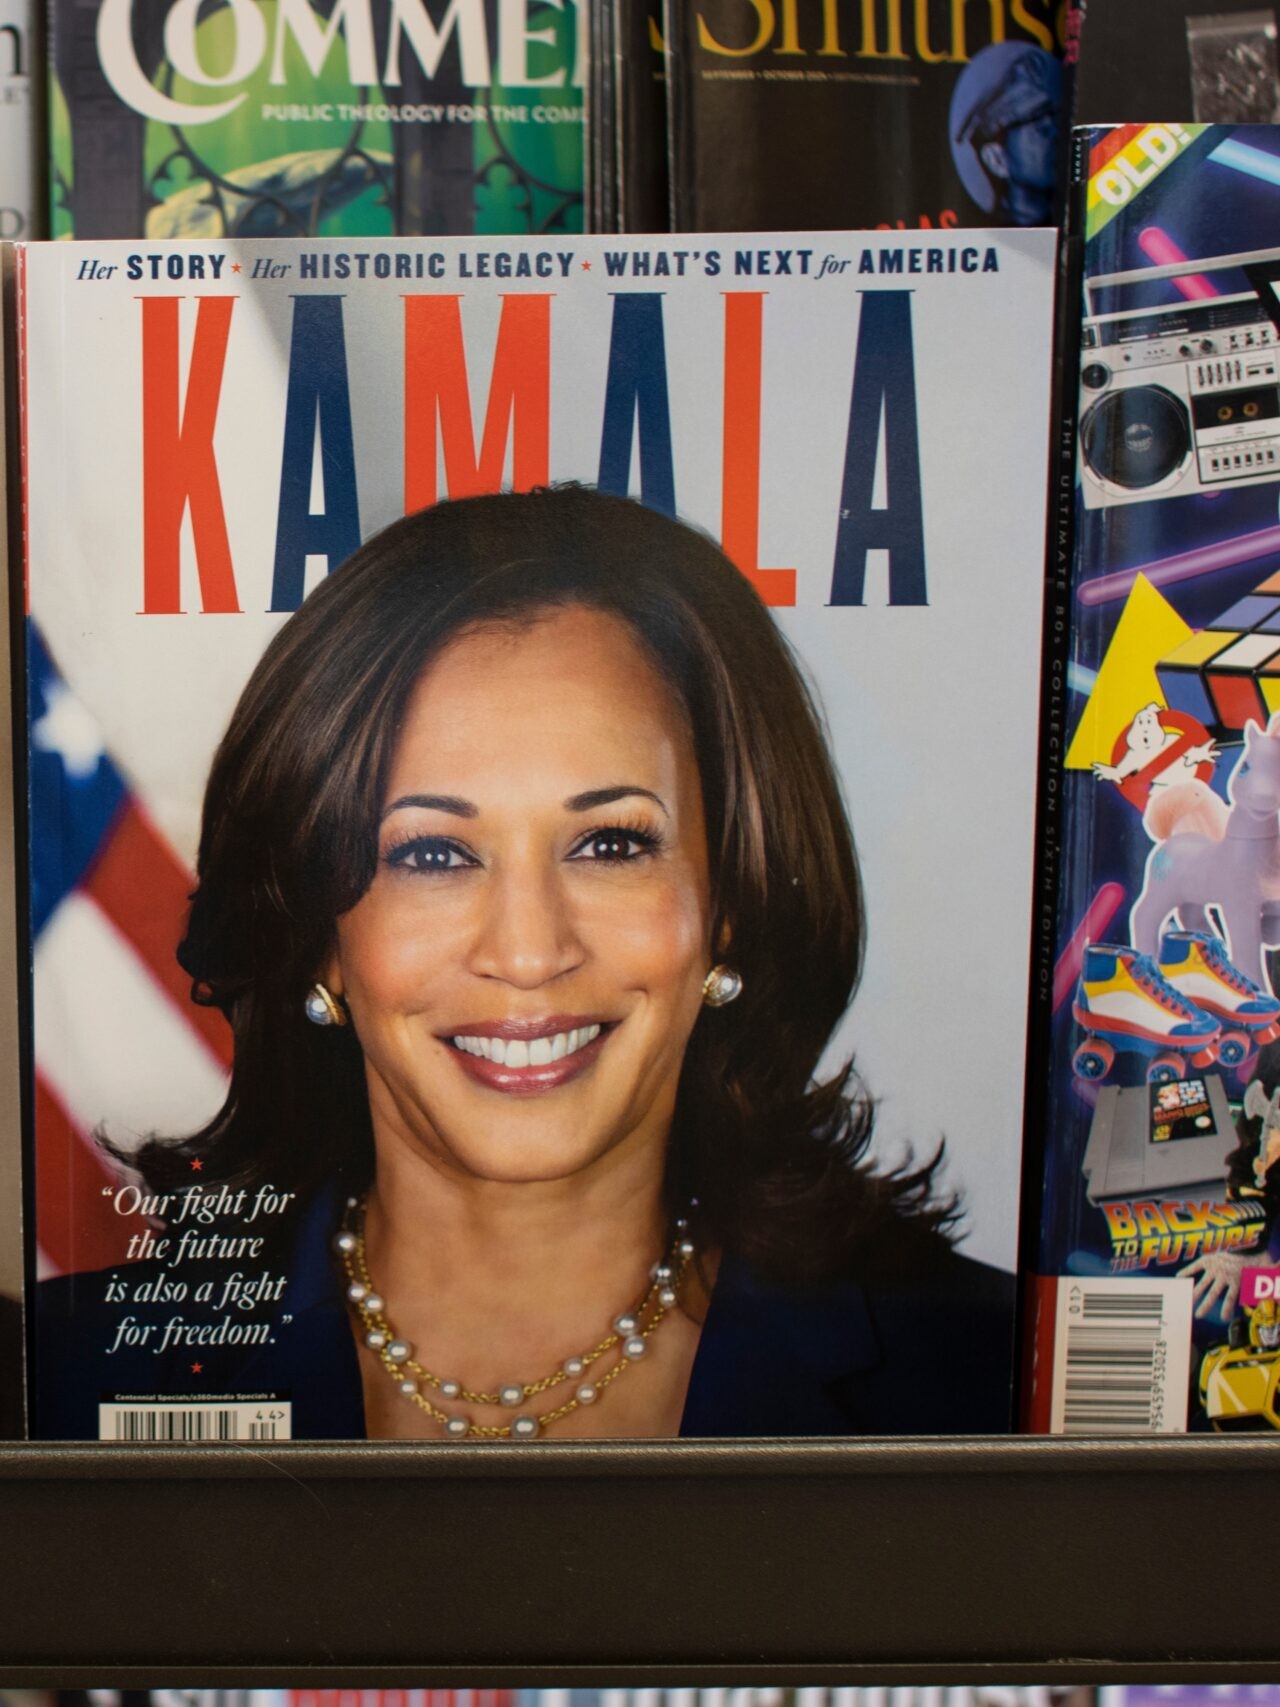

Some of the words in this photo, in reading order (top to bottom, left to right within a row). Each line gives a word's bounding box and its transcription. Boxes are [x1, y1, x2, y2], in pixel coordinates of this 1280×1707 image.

[262, 104, 333, 121] PUBLIC
[337, 104, 444, 122] THEOLOGY
[448, 105, 487, 122] FOR
[491, 105, 528, 122] THE
[1095, 122, 1193, 205] OLD!
[76, 258, 119, 282] Her
[126, 253, 226, 281] STORY
[251, 256, 292, 280] Her
[299, 252, 446, 280] HISTORIC
[458, 251, 574, 280] LEGACY
[604, 249, 721, 278] WHAT’S
[734, 249, 813, 276] NEXT
[815, 252, 851, 280] for
[857, 247, 1000, 274] AMERICA
[134, 289, 928, 615] KAMALA
[1060, 418, 1072, 459] THE
[1056, 475, 1070, 590] ULTIMATE
[1046, 659, 1063, 812] COLLECTION
[1043, 827, 1056, 894] SIXTH
[1038, 903, 1052, 1003] EDITION
[172, 1185, 248, 1224] fight
[243, 1184, 295, 1223] for
[1101, 1201, 1240, 1240] BACK
[126, 1229, 170, 1259] the
[168, 1229, 264, 1267] future
[1111, 1256, 1139, 1274] THE
[1112, 1239, 1139, 1257] TO
[1138, 1222, 1266, 1270] FUTURE
[104, 1274, 128, 1302] is
[133, 1273, 188, 1302] also
[194, 1281, 214, 1301] a
[212, 1271, 288, 1310] fight
[105, 1316, 157, 1354] for
[115, 1393, 156, 1401] Centennial
[236, 1392, 269, 1401] Specials
